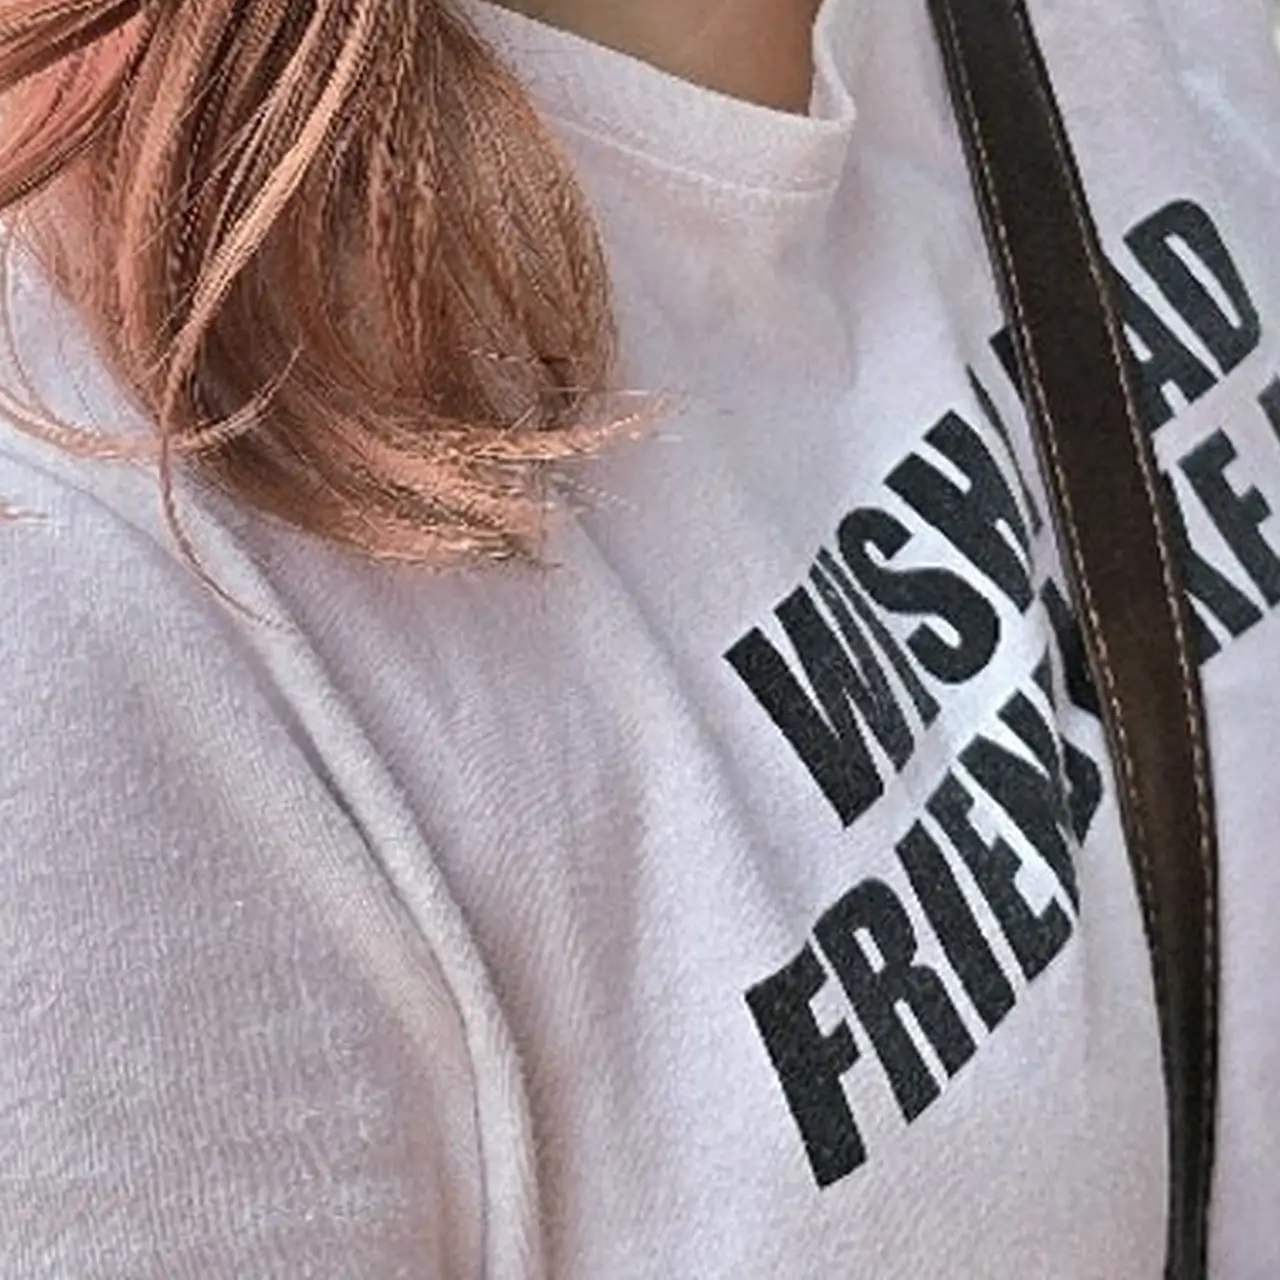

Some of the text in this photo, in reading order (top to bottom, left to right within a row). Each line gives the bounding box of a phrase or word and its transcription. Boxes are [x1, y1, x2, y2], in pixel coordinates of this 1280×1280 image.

[722, 408, 1035, 828] WISH
[988, 197, 1261, 440] AD
[744, 643, 1104, 1190] FRIEN
